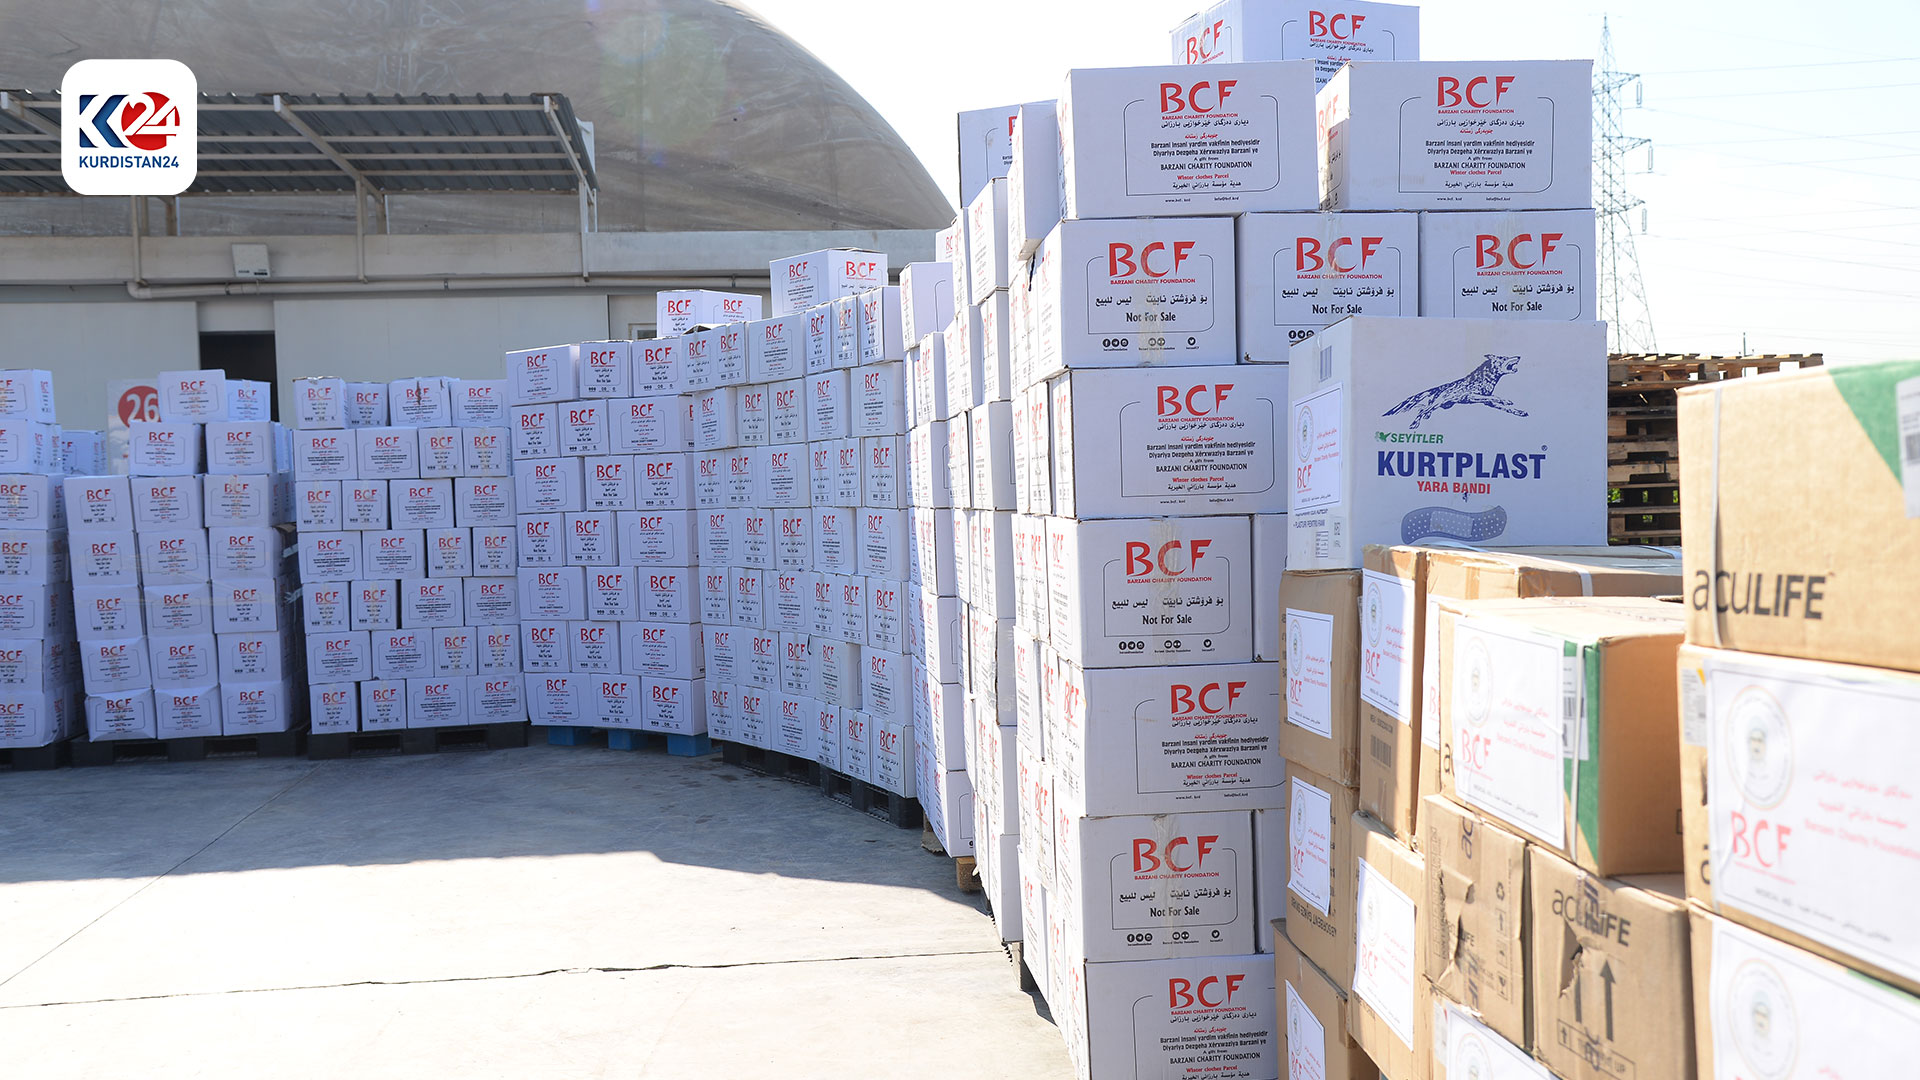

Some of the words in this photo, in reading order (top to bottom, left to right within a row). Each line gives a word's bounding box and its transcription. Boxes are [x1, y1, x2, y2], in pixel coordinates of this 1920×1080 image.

[1309, 11, 1366, 40] BCF
[1187, 19, 1223, 64] BCF
[1160, 80, 1237, 114] BCF
[1438, 76, 1515, 108] BCF
[1296, 237, 1383, 272] BCF
[1476, 233, 1563, 269] BCF
[1109, 242, 1195, 277] BCF
[789, 262, 808, 277] BCF
[846, 261, 876, 276] BCF
[668, 300, 691, 313] BCF
[1312, 305, 1327, 314] Not
[1331, 305, 1344, 314] For
[1347, 304, 1362, 314] Sale
[1492, 302, 1507, 311] Not
[1511, 302, 1523, 311] For
[1527, 302, 1542, 311] Sale
[1126, 312, 1141, 322] Not
[1145, 312, 1157, 321] For
[1161, 312, 1176, 321] Sale
[766, 324, 783, 340] BCF
[590, 352, 616, 365] BCF
[645, 347, 672, 362] BCF
[181, 381, 205, 391] BCF
[468, 387, 491, 398] BCF
[777, 390, 794, 406] BCF
[1157, 384, 1234, 416] BCF
[126, 393, 160, 422] 26
[632, 404, 654, 416] BCF
[522, 413, 544, 427] BCF
[150, 432, 174, 442] BCF
[228, 432, 252, 442] BCF
[312, 438, 336, 448] BCF
[1390, 431, 1443, 444] SEYİTLER
[772, 452, 788, 468] BCF
[1377, 451, 1546, 479] KURTPLAST
[648, 462, 672, 477] BCF
[1296, 464, 1312, 488] BCF
[86, 489, 110, 500] BCF
[1417, 481, 1448, 492] YARA
[1453, 482, 1491, 495] BANDI
[576, 520, 598, 534] BCF
[783, 518, 802, 534] BCF
[230, 535, 254, 546] BCF
[485, 536, 507, 548] BCF
[1126, 540, 1212, 577] BCF
[650, 576, 676, 590] BCF
[420, 585, 444, 596] BCF
[1693, 570, 1826, 619] acuLIFE
[164, 593, 188, 606] BCF
[876, 590, 894, 608] BCF
[1143, 615, 1157, 625] Not
[1161, 615, 1173, 624] For
[1177, 614, 1192, 624] Sale
[531, 628, 554, 642] BCF
[643, 628, 666, 640] BCF
[240, 641, 262, 653] BCF
[326, 639, 350, 651] BCF
[1366, 649, 1380, 677] BCF
[602, 682, 627, 696] BCF
[652, 686, 678, 700] BCF
[1290, 678, 1302, 703] BCF
[1171, 682, 1247, 714] BCF
[880, 730, 896, 750] BCF
[1462, 729, 1491, 770] BCF
[1224, 758, 1261, 766] FOUNDATION
[1731, 811, 1792, 868] BCF
[1133, 835, 1218, 873] BCF
[1150, 908, 1165, 917] Not
[1169, 907, 1181, 916] For
[1185, 906, 1200, 915] Sale
[1169, 974, 1245, 1009] BCF
[1223, 1052, 1260, 1061] FOUNDATION
